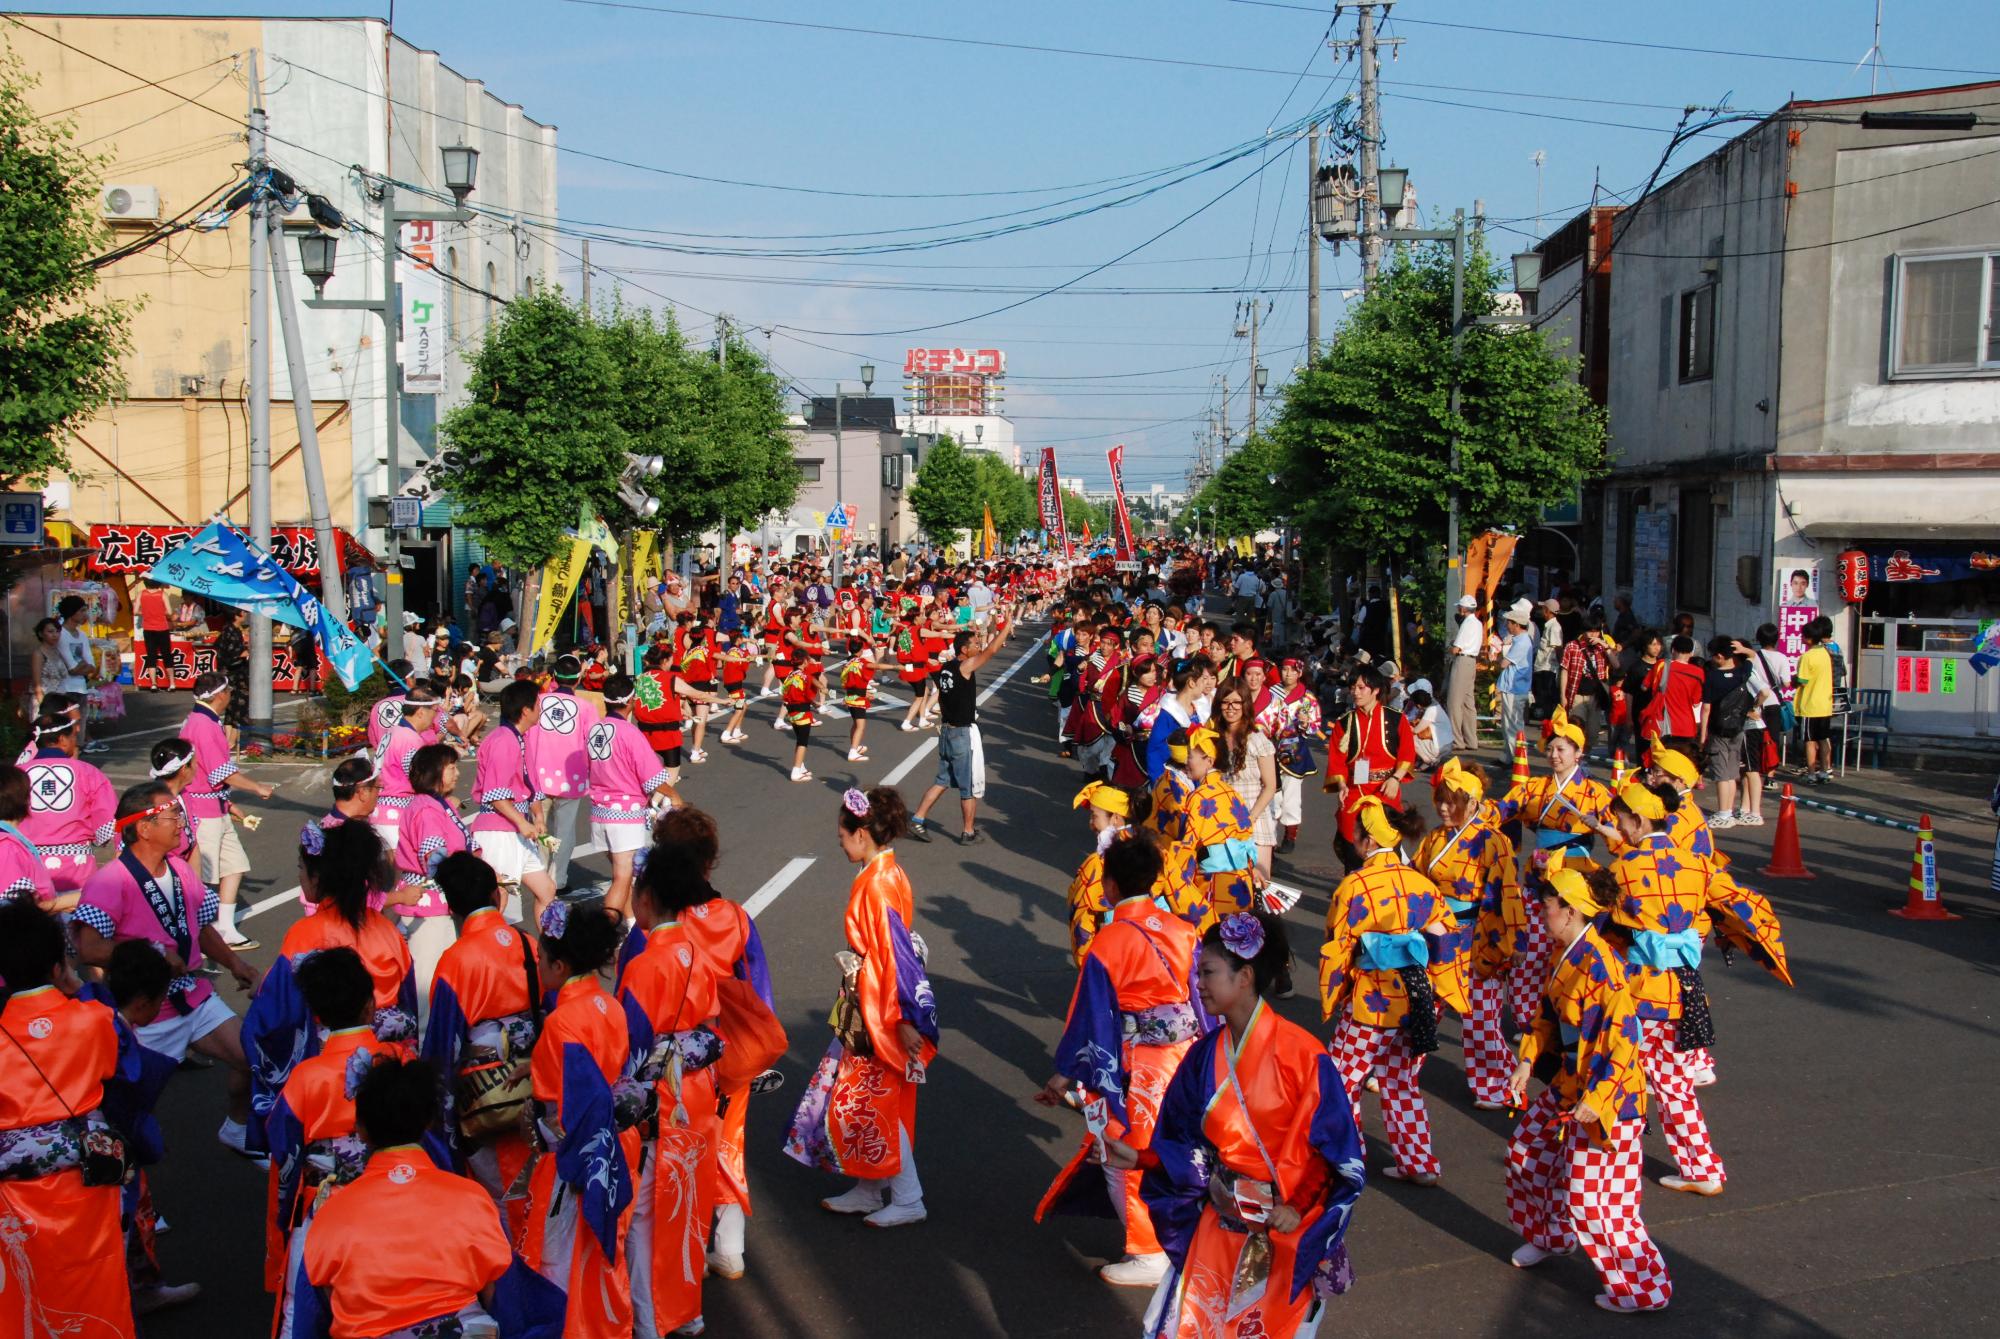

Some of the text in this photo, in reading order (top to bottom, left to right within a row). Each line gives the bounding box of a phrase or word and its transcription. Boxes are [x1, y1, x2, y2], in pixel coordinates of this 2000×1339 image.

[418, 327, 429, 376] スタジオ
[904, 348, 1000, 373] パチンコ
